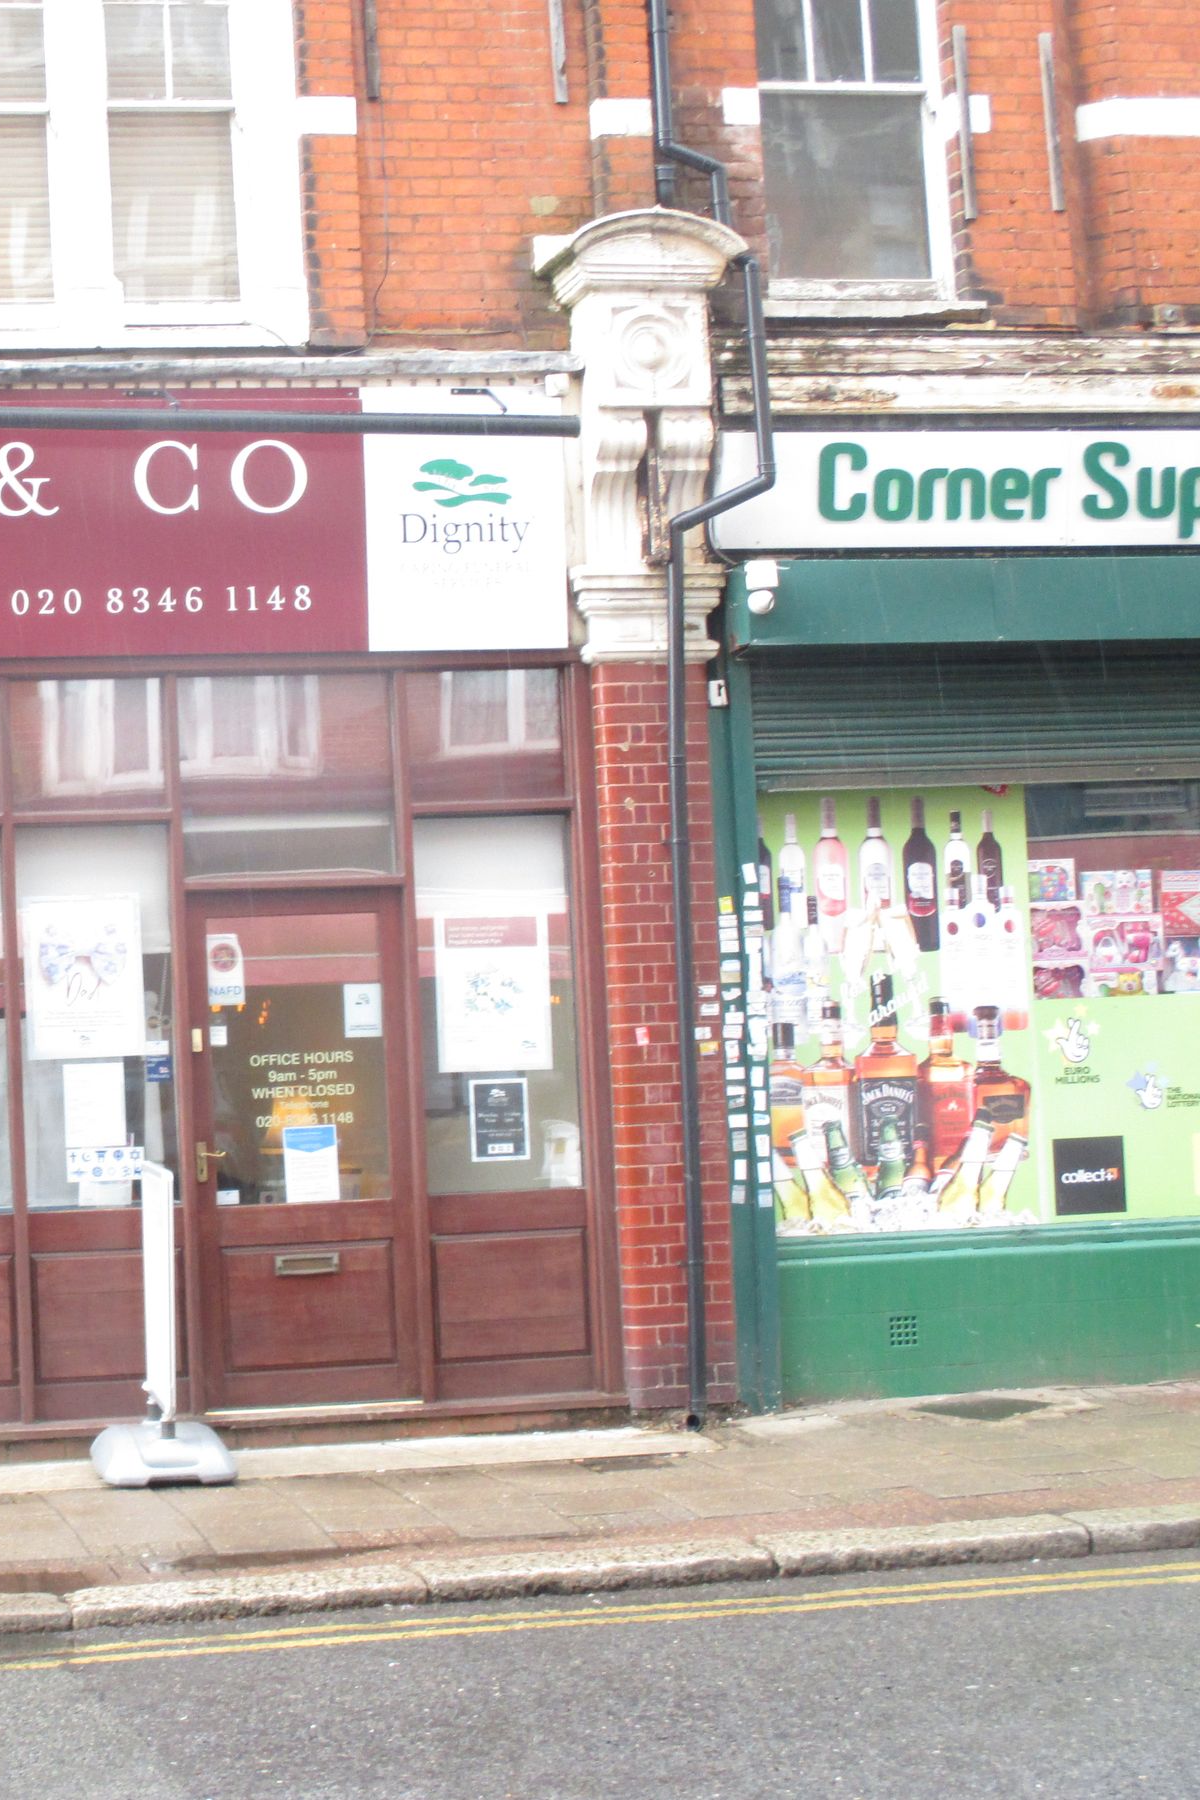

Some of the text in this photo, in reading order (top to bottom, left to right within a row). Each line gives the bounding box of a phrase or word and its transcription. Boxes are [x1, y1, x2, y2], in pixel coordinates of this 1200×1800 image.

[133, 440, 308, 515] CO
[818, 442, 1062, 522] Corner
[400, 513, 530, 554] Dignity
[11, 585, 312, 615] 020 8346 1148
[209, 985, 242, 996] NAFD
[249, 1050, 354, 1067] OFFICE HOURS
[268, 1070, 297, 1083] 9am
[308, 1068, 337, 1083] 5pm
[1055, 1075, 1101, 1085] MILLIONS
[251, 1083, 355, 1099] WHEN CLOSED
[322, 1112, 354, 1124] 1148
